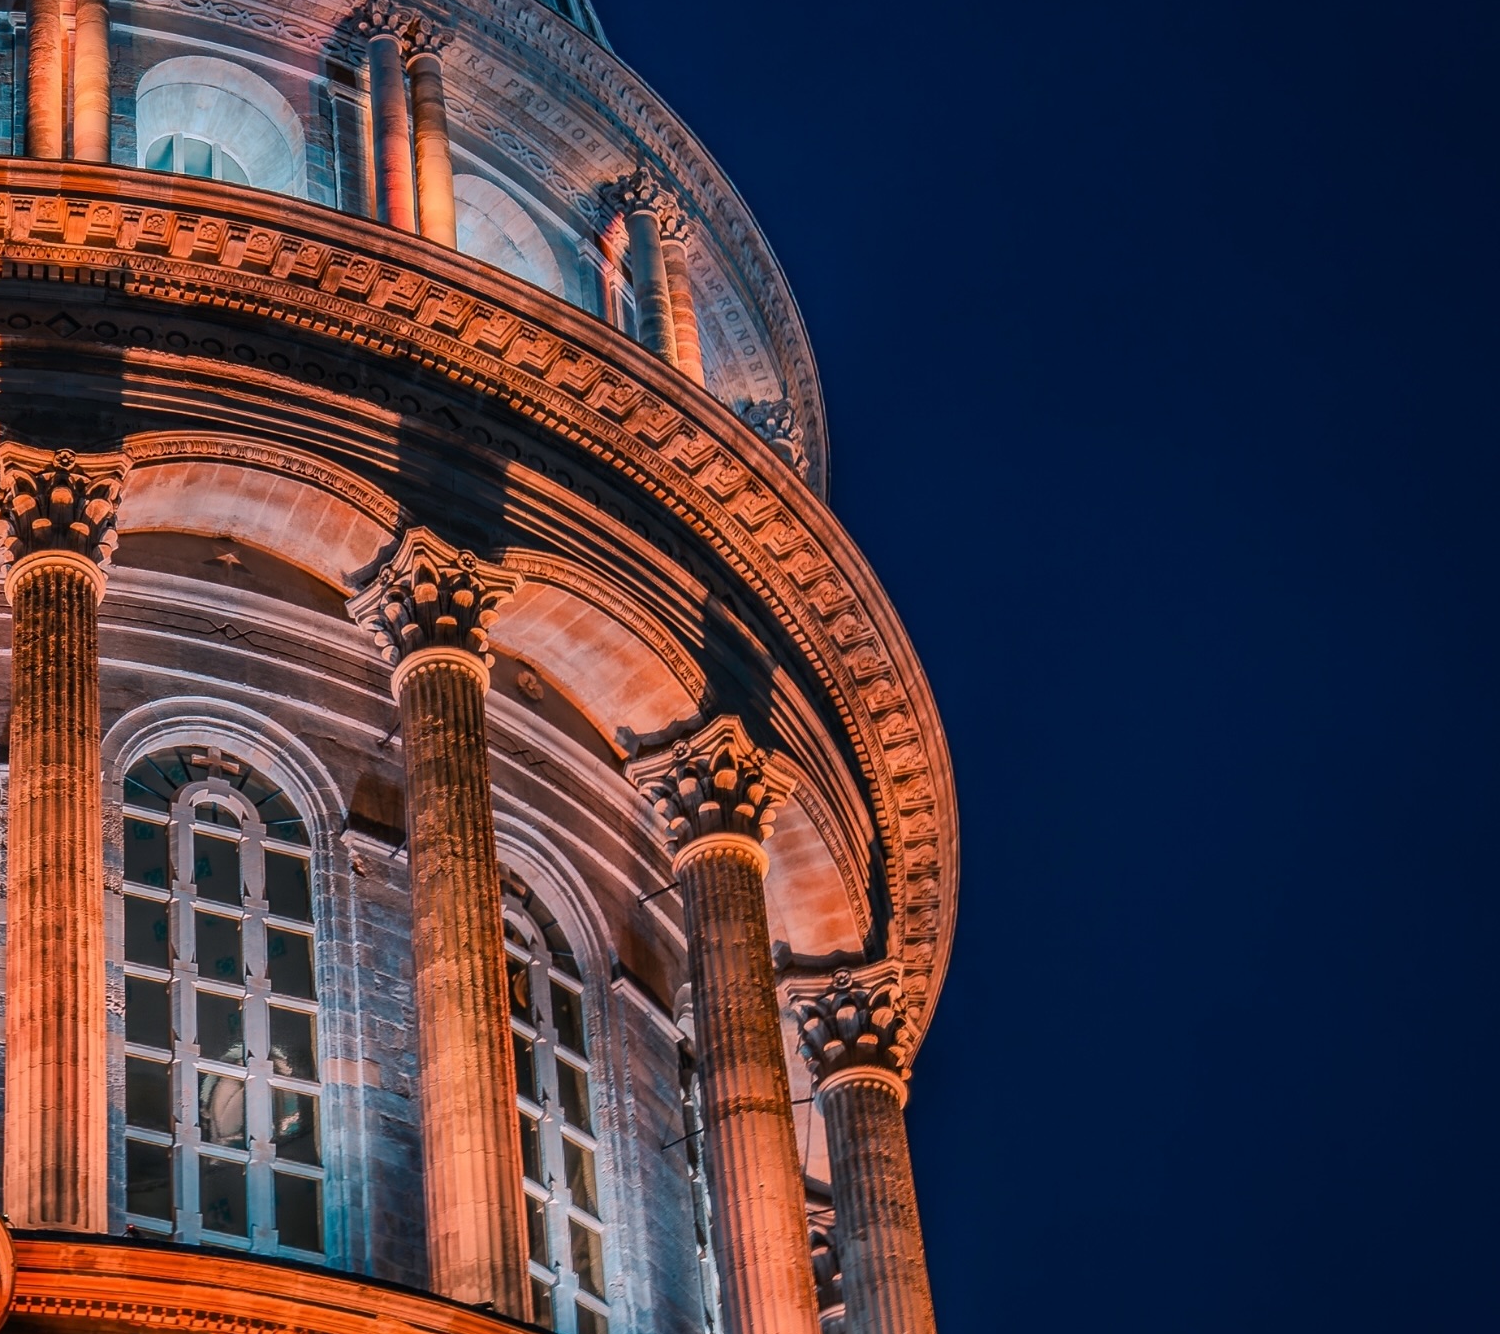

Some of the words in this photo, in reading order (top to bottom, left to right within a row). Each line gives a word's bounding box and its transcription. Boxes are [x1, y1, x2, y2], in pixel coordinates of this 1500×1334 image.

[450, 45, 497, 81] ORA
[503, 78, 551, 113] PRO
[555, 112, 624, 174] NOBIS
[708, 283, 740, 322] PRO
[733, 327, 773, 398] NOBIS
